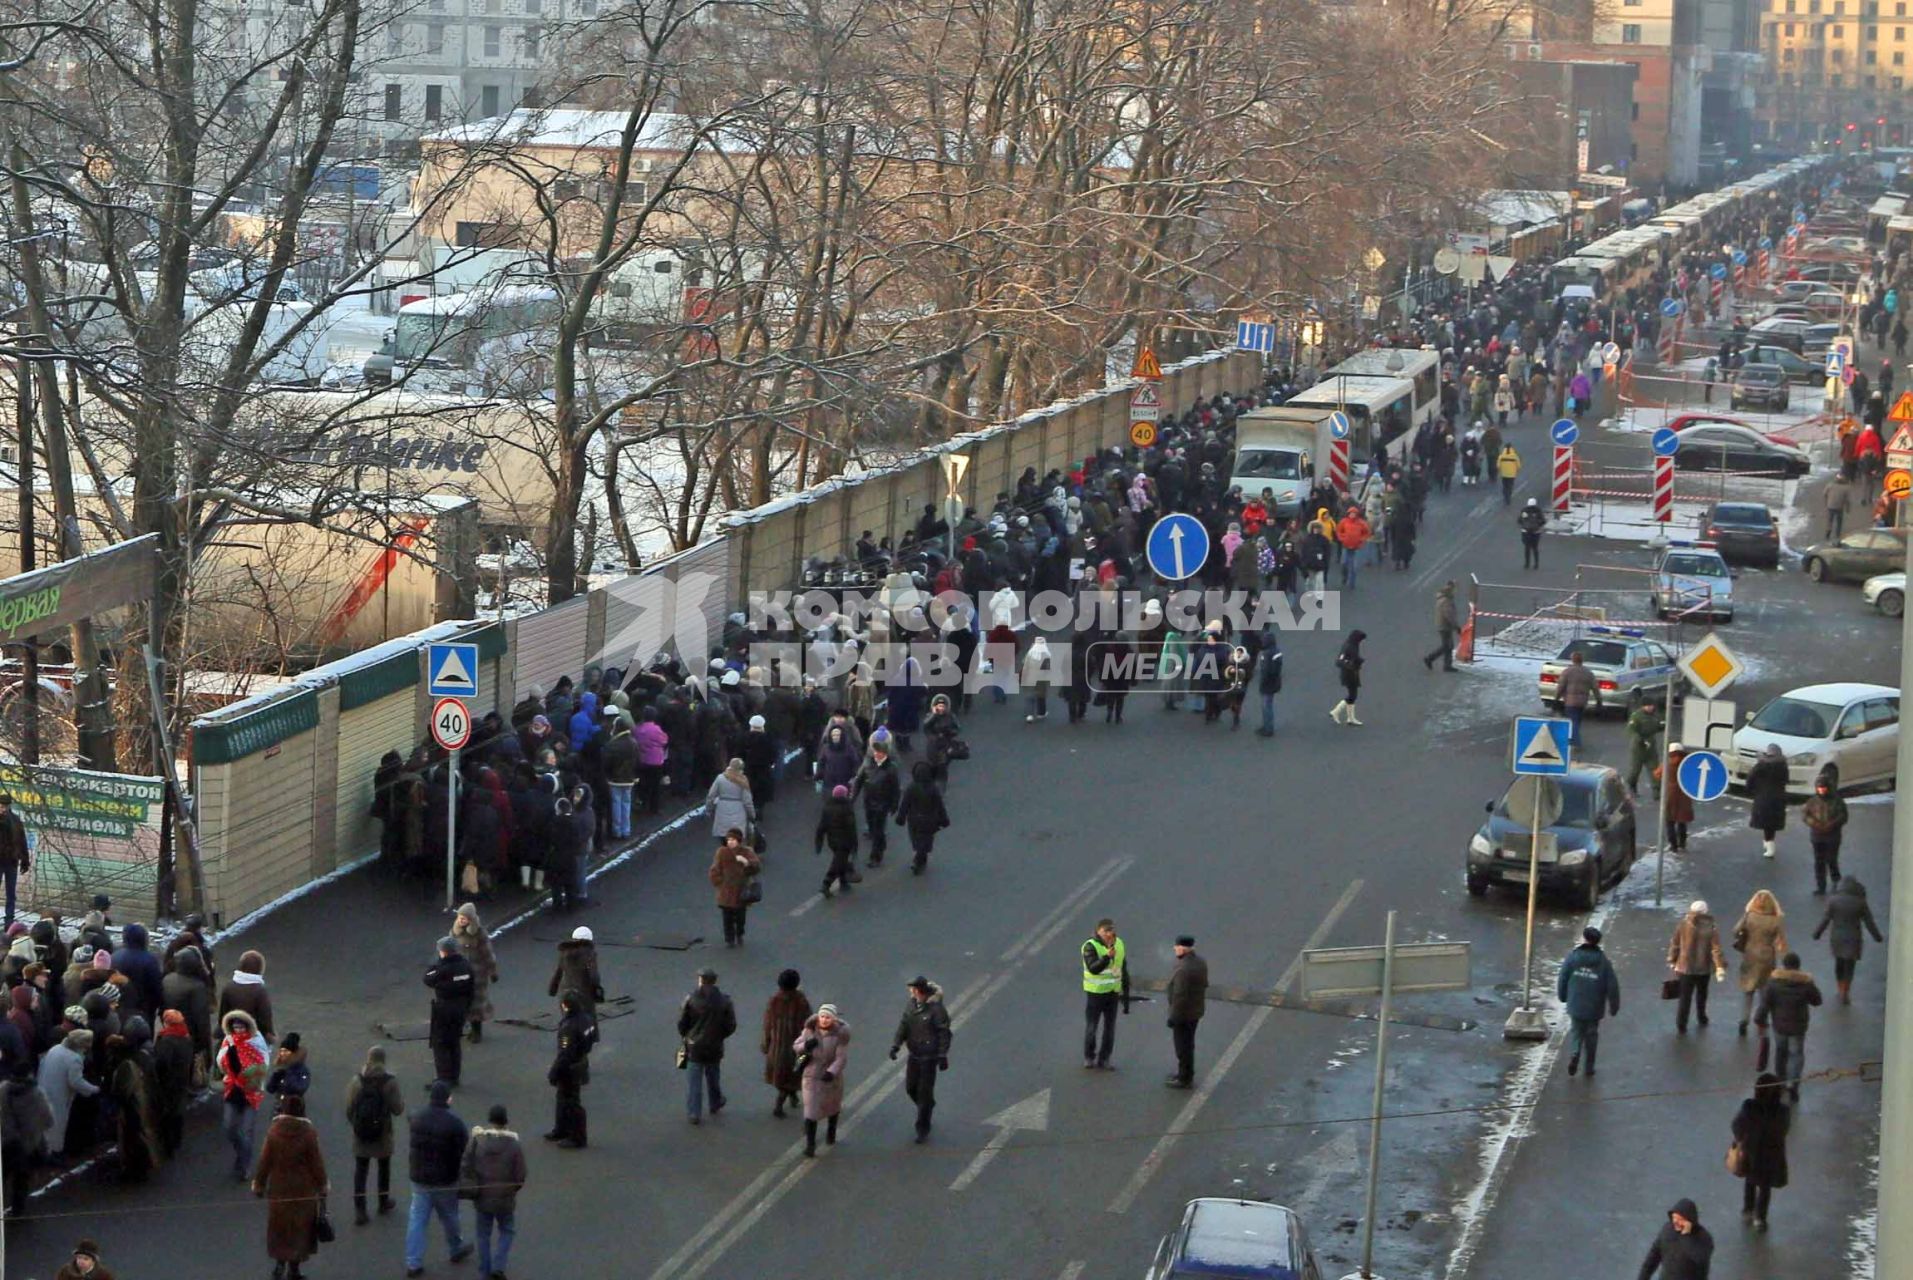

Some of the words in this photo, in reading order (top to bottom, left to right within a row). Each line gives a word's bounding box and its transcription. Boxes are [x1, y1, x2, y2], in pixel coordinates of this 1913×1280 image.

[1135, 430, 1151, 440] 40
[0, 585, 60, 639] ервая
[440, 714, 462, 733] 40
